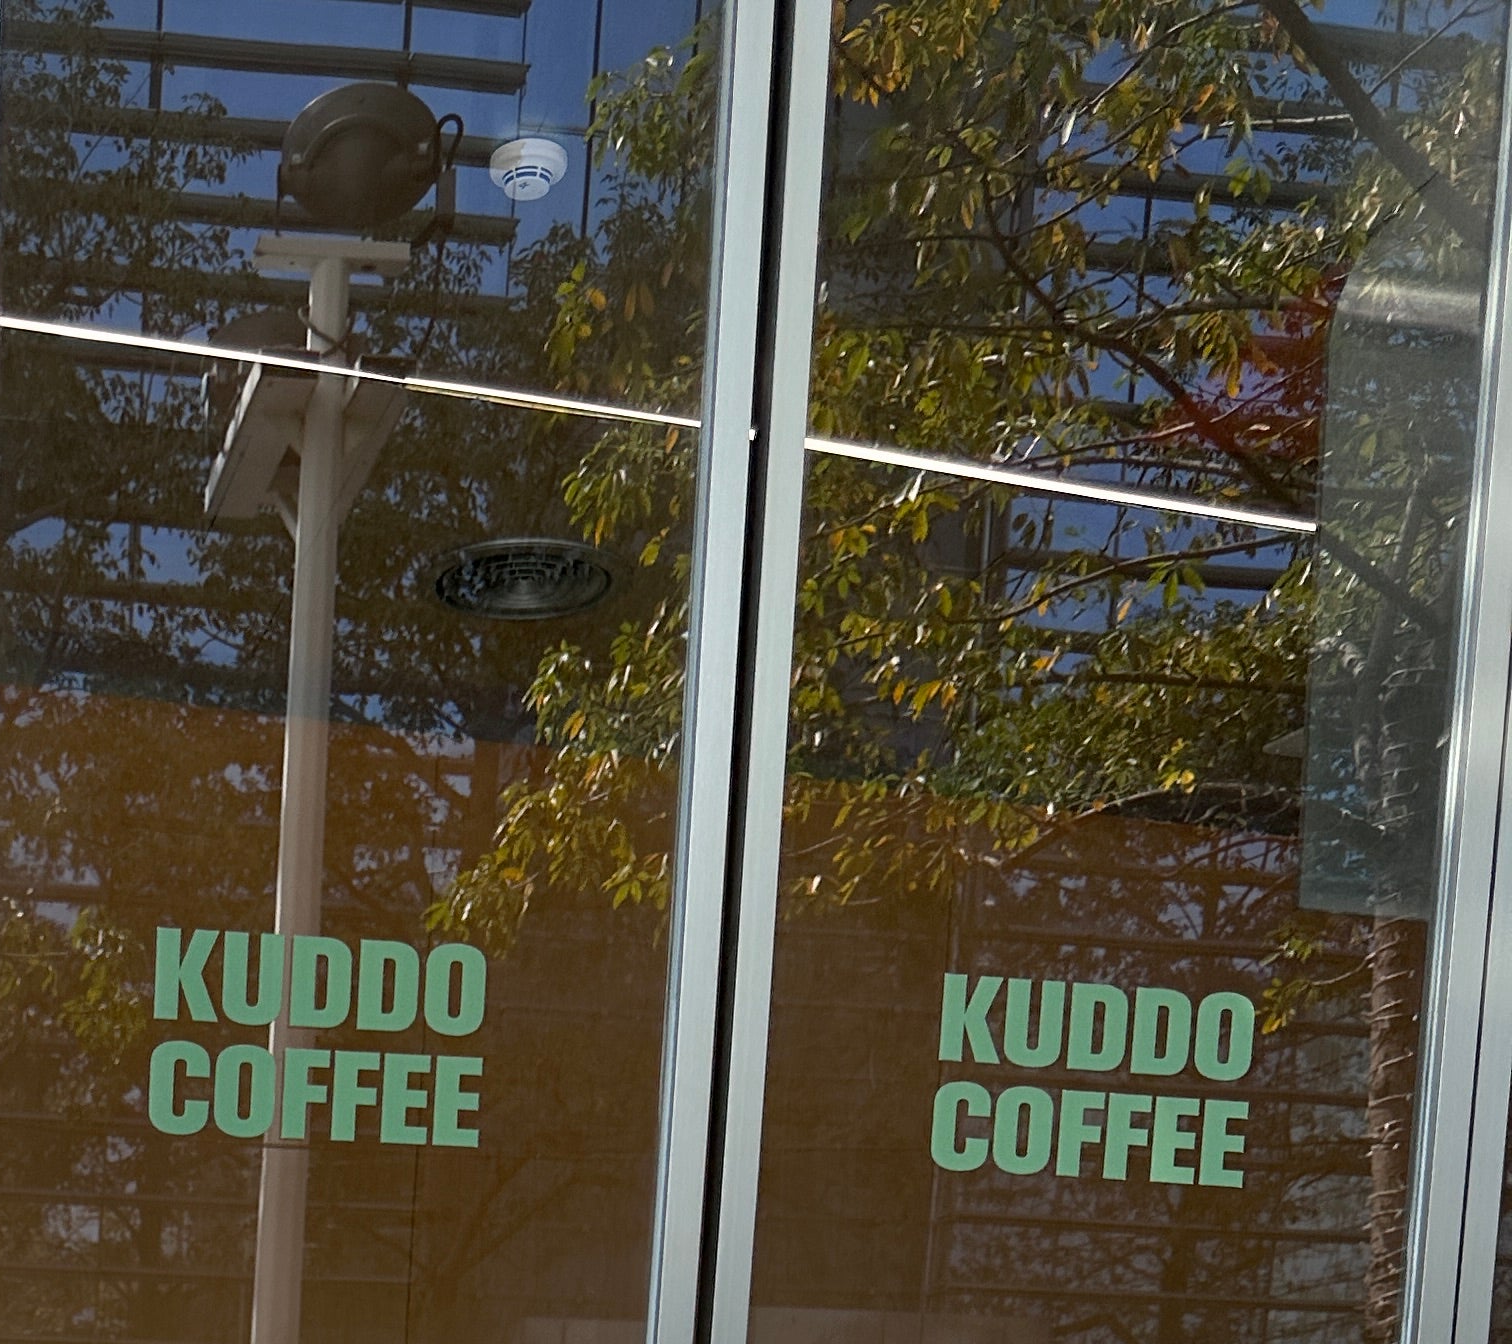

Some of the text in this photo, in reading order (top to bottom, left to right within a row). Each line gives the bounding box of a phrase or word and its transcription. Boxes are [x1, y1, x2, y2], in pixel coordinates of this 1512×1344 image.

[154, 926, 486, 1036] KUDDO
[939, 972, 1255, 1081] KUDDO
[148, 1040, 484, 1148] COFFEE
[930, 1081, 1249, 1188] COFFEE
